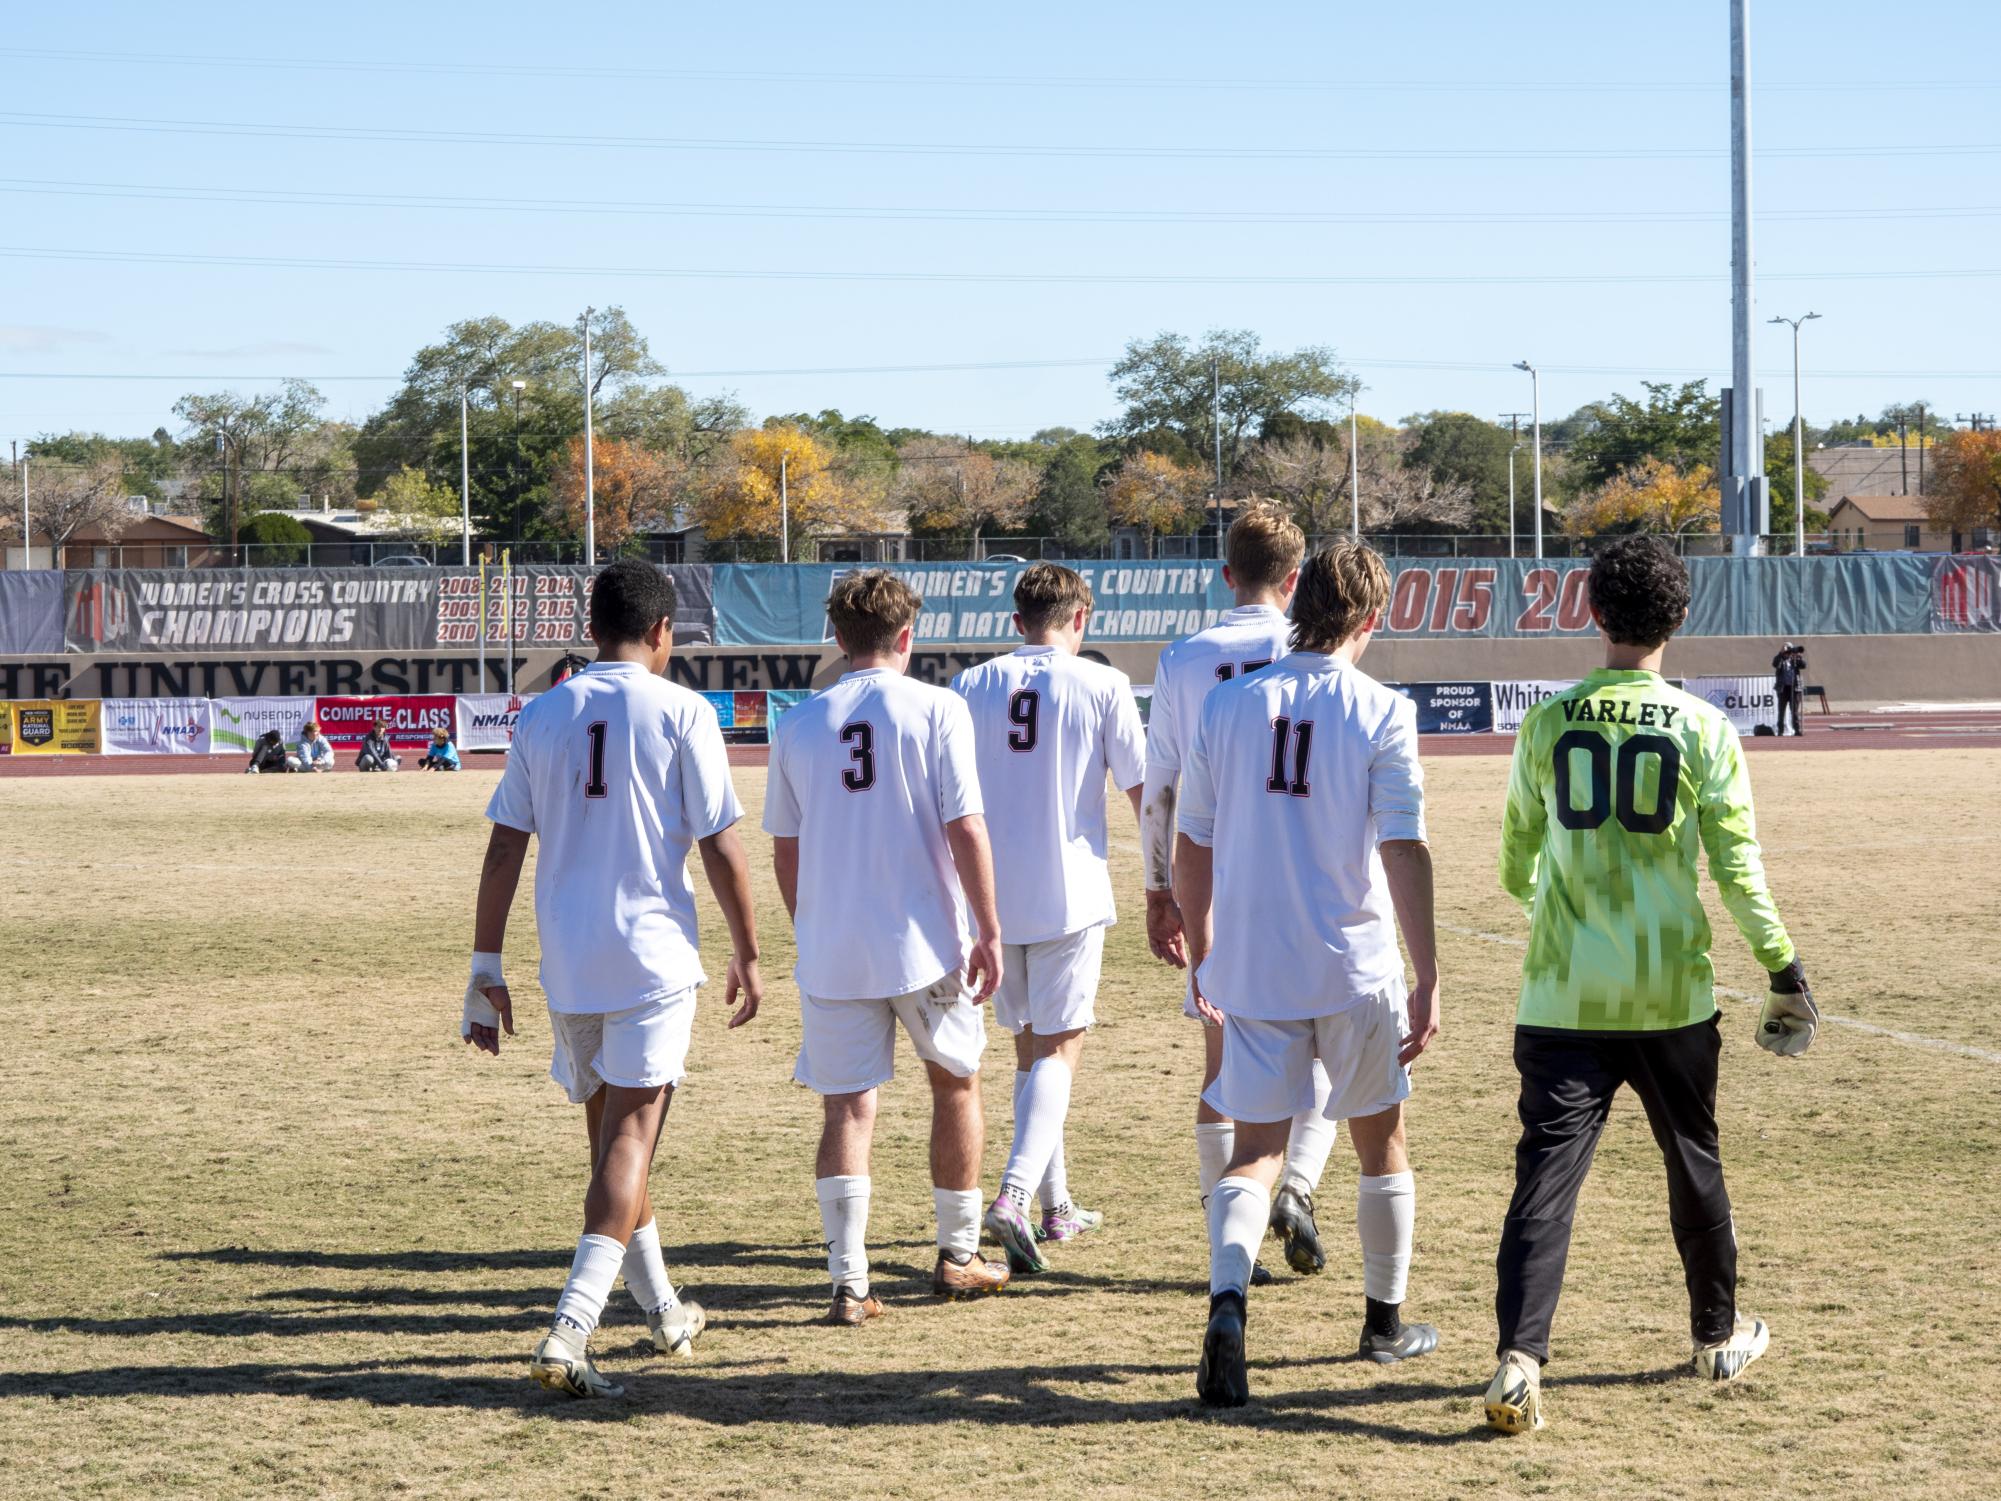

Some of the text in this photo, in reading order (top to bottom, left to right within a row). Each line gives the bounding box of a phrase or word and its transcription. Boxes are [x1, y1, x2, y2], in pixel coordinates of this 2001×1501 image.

[438, 576, 481, 596] 2008
[535, 576, 575, 595] 2014
[1100, 568, 1214, 595] COUNTRY
[138, 580, 434, 606] WOMEN'S CROSS COUNTRY
[1371, 568, 1497, 632] 015
[437, 600, 480, 619] 2009
[536, 599, 577, 619] 2015
[139, 608, 356, 644] CHAMPIONS
[437, 622, 477, 641] 2010
[534, 622, 575, 641] 2016
[94, 656, 527, 699] UNIVERSITY
[1436, 686, 1475, 695] PROUD
[1430, 698, 1481, 707] SPONSOR
[1725, 695, 1774, 709] CLUB
[23, 716, 49, 724] ARMY
[320, 706, 392, 720] COMPETE
[396, 708, 450, 729] CLASS
[1008, 688, 1040, 752] 9
[1448, 710, 1463, 719] OF
[1562, 698, 1680, 728] VARLEY
[162, 726, 195, 735] NMAA
[1440, 722, 1472, 731] NMAA
[585, 721, 608, 798] 1
[839, 720, 877, 792] 3
[1266, 716, 1314, 797] 11
[1553, 729, 1680, 834] 00
